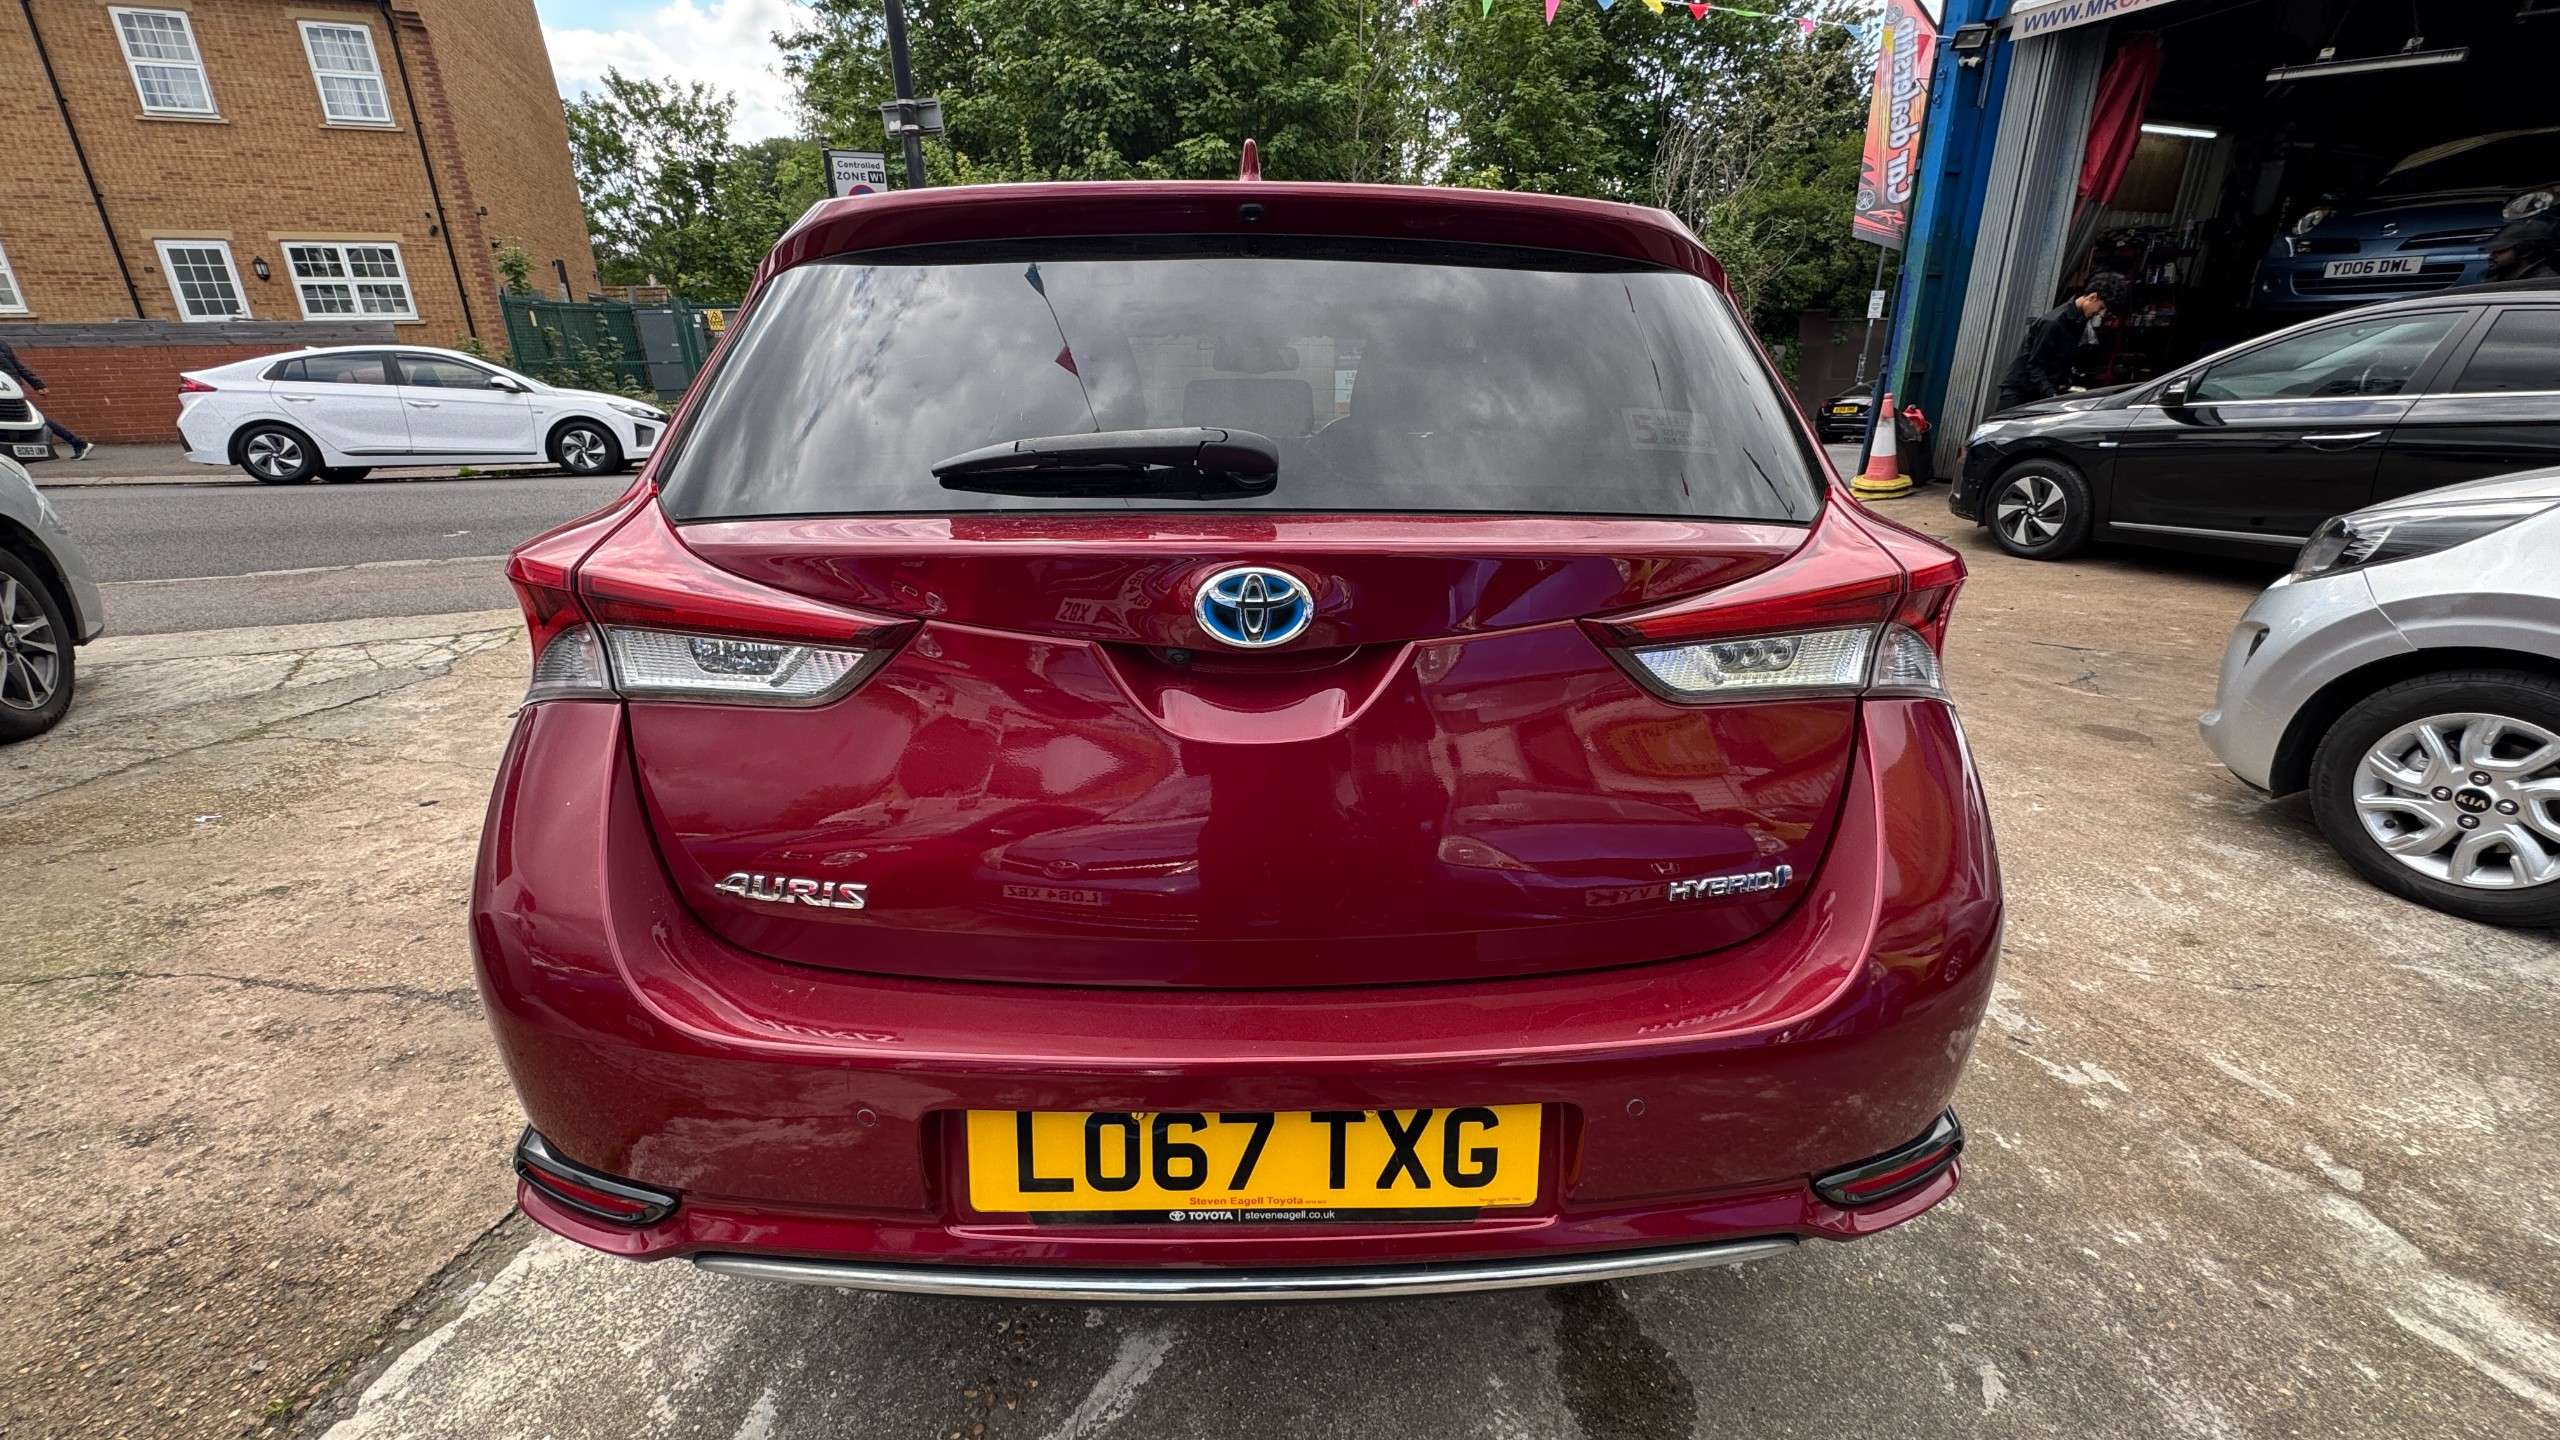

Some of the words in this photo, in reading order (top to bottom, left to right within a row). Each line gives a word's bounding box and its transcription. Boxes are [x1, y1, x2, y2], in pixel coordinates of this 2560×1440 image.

[2024, 0, 2151, 33] WWW.MR
[837, 160, 880, 170] Controlled
[836, 172, 866, 181] ZONE
[869, 172, 884, 183] W1
[2333, 261, 2375, 276] YD06
[2378, 259, 2412, 274] DWL
[2457, 794, 2487, 809] KIA
[714, 872, 868, 910] AURIS
[1669, 872, 1775, 901] HYBRID
[1016, 1111, 1275, 1192] LO67
[1311, 1107, 1499, 1189] TXG
[1190, 1196, 1226, 1206] Steven
[1230, 1196, 1263, 1207] Eagell
[1267, 1196, 1303, 1207] Toyota
[1188, 1211, 1233, 1221] TOYOTA
[1245, 1209, 1335, 1221] steveneagell.co.uk
